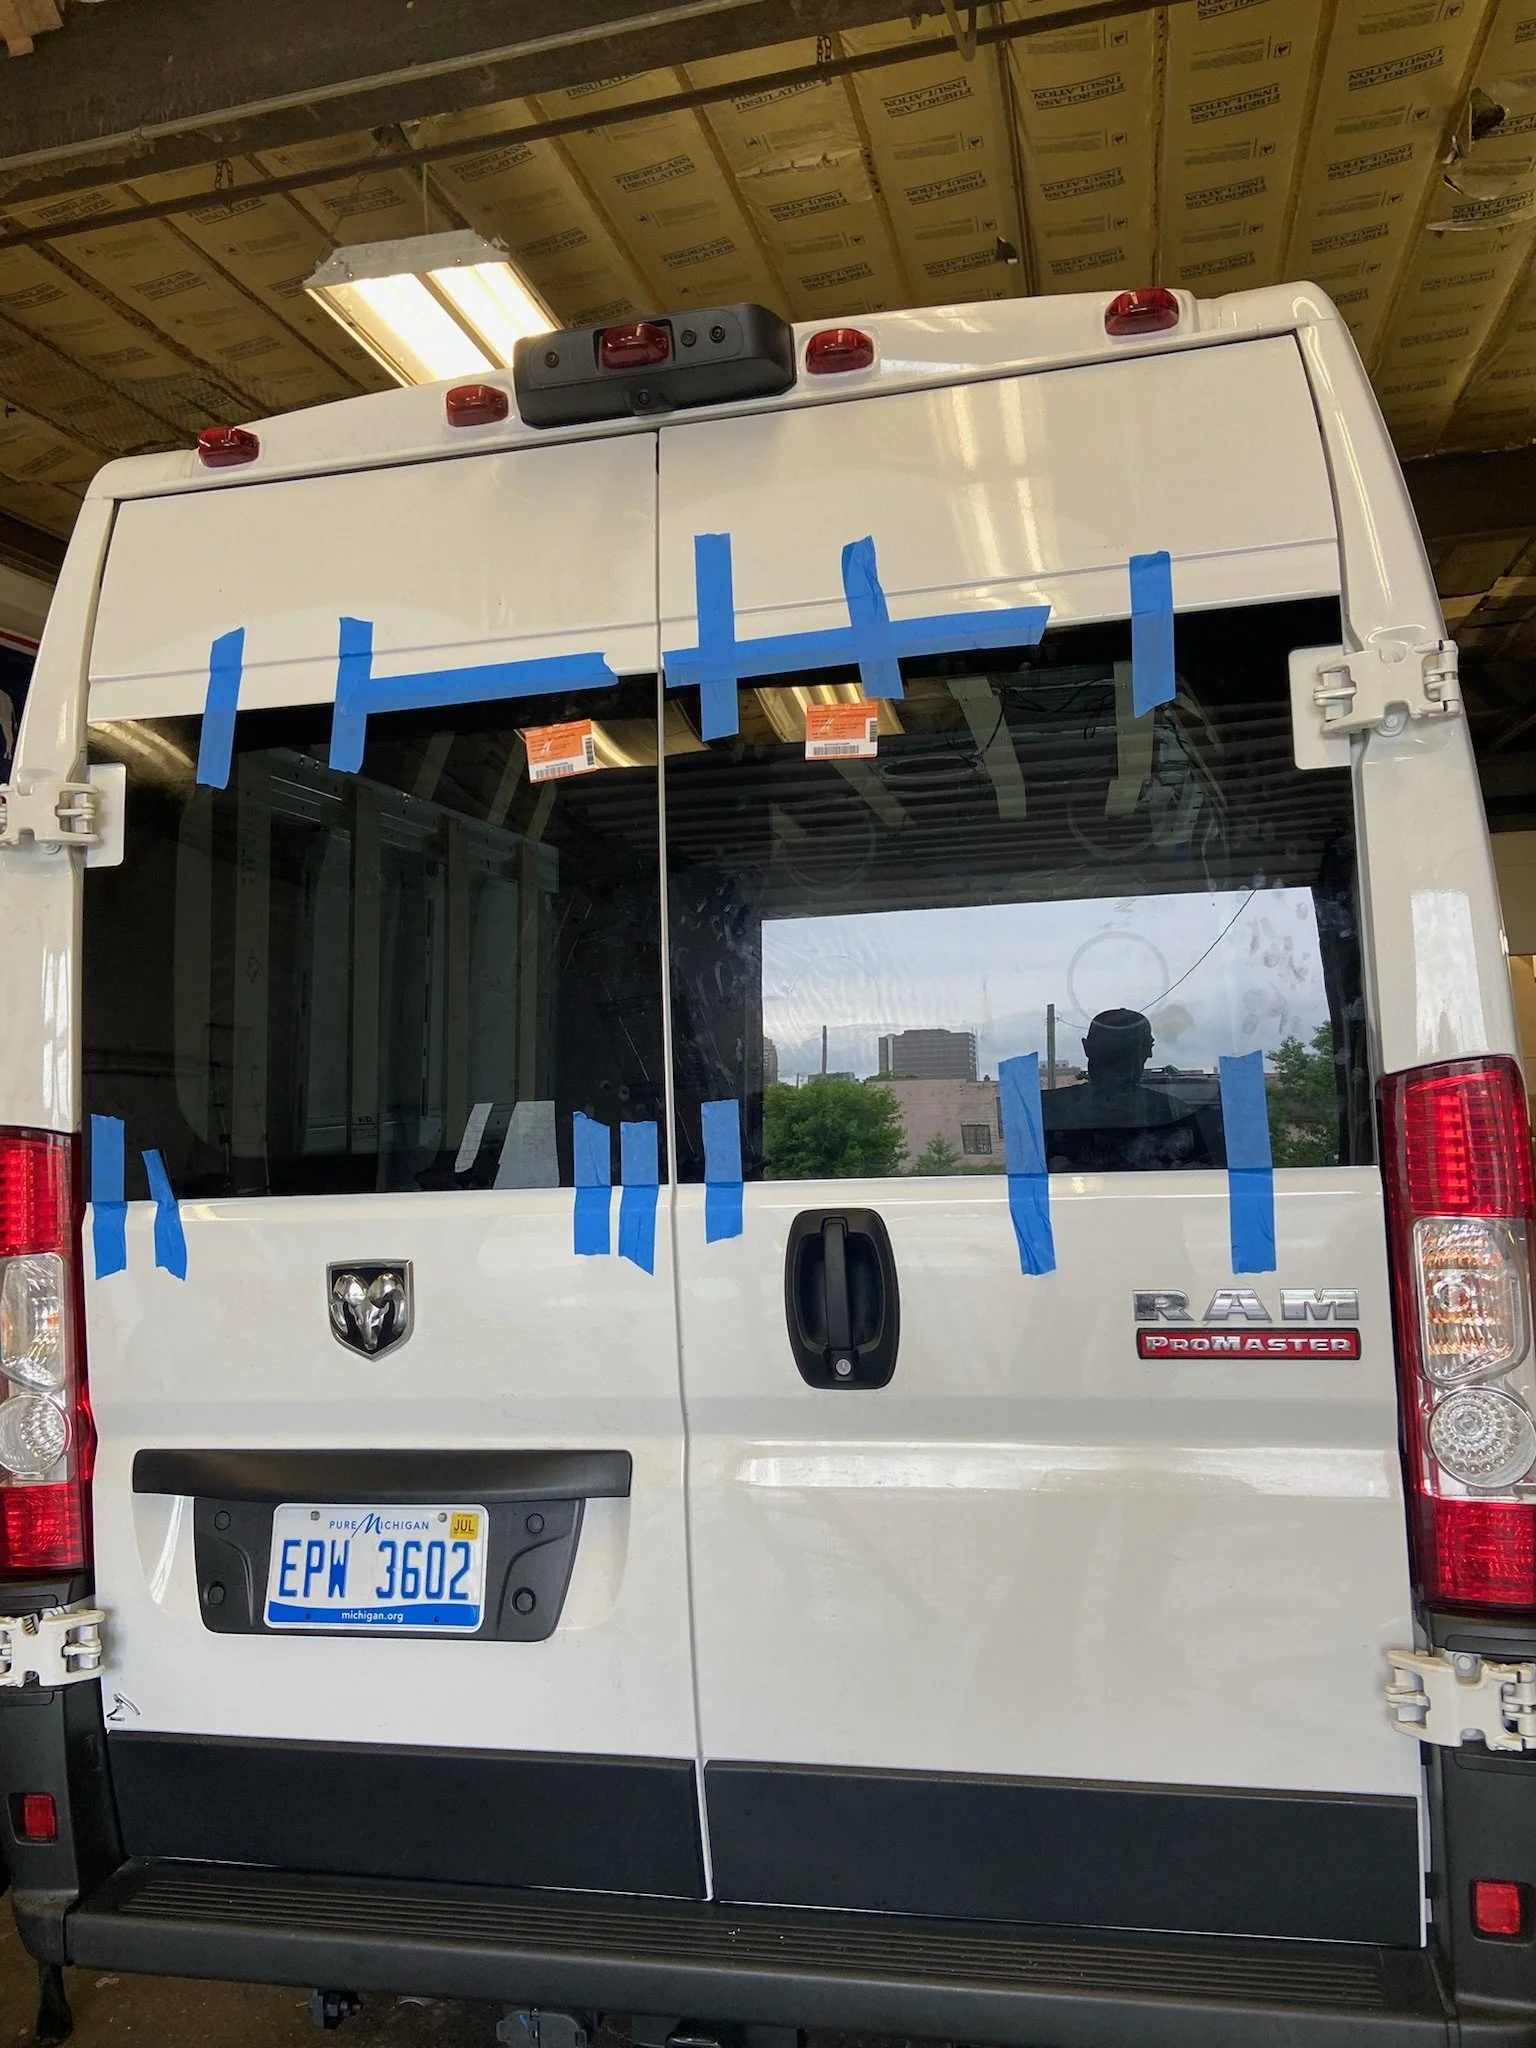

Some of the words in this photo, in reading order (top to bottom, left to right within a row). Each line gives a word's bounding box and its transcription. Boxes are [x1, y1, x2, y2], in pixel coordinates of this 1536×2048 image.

[884, 79, 967, 107] INSULATION
[1033, 75, 1121, 100] INSULATION
[1036, 83, 1124, 108] FIBERGLASS
[886, 88, 972, 115] FIBERGLASS
[1132, 1288, 1360, 1321] RAM
[329, 1521, 357, 1530] PURE
[351, 1513, 430, 1538] MICHIGAN
[454, 1520, 475, 1532] JUL
[278, 1539, 350, 1598] EPW
[375, 1540, 472, 1601] 3602
[341, 1610, 404, 1623] michigan.org
